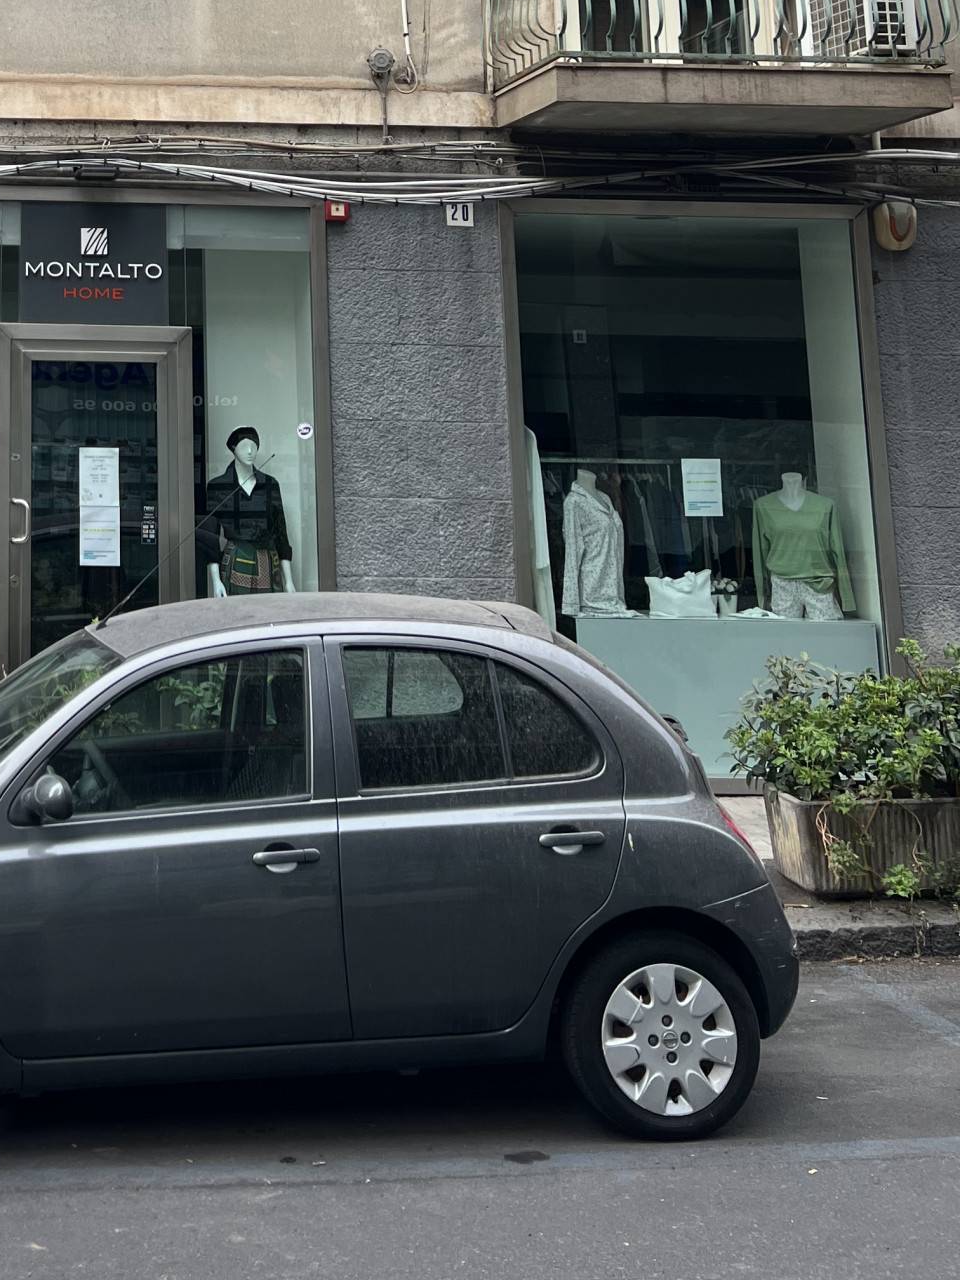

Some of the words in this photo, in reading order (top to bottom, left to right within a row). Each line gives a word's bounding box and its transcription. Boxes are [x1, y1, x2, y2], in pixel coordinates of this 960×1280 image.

[451, 204, 469, 222] 20
[25, 261, 163, 279] MONTALTO
[63, 287, 125, 300] HOME
